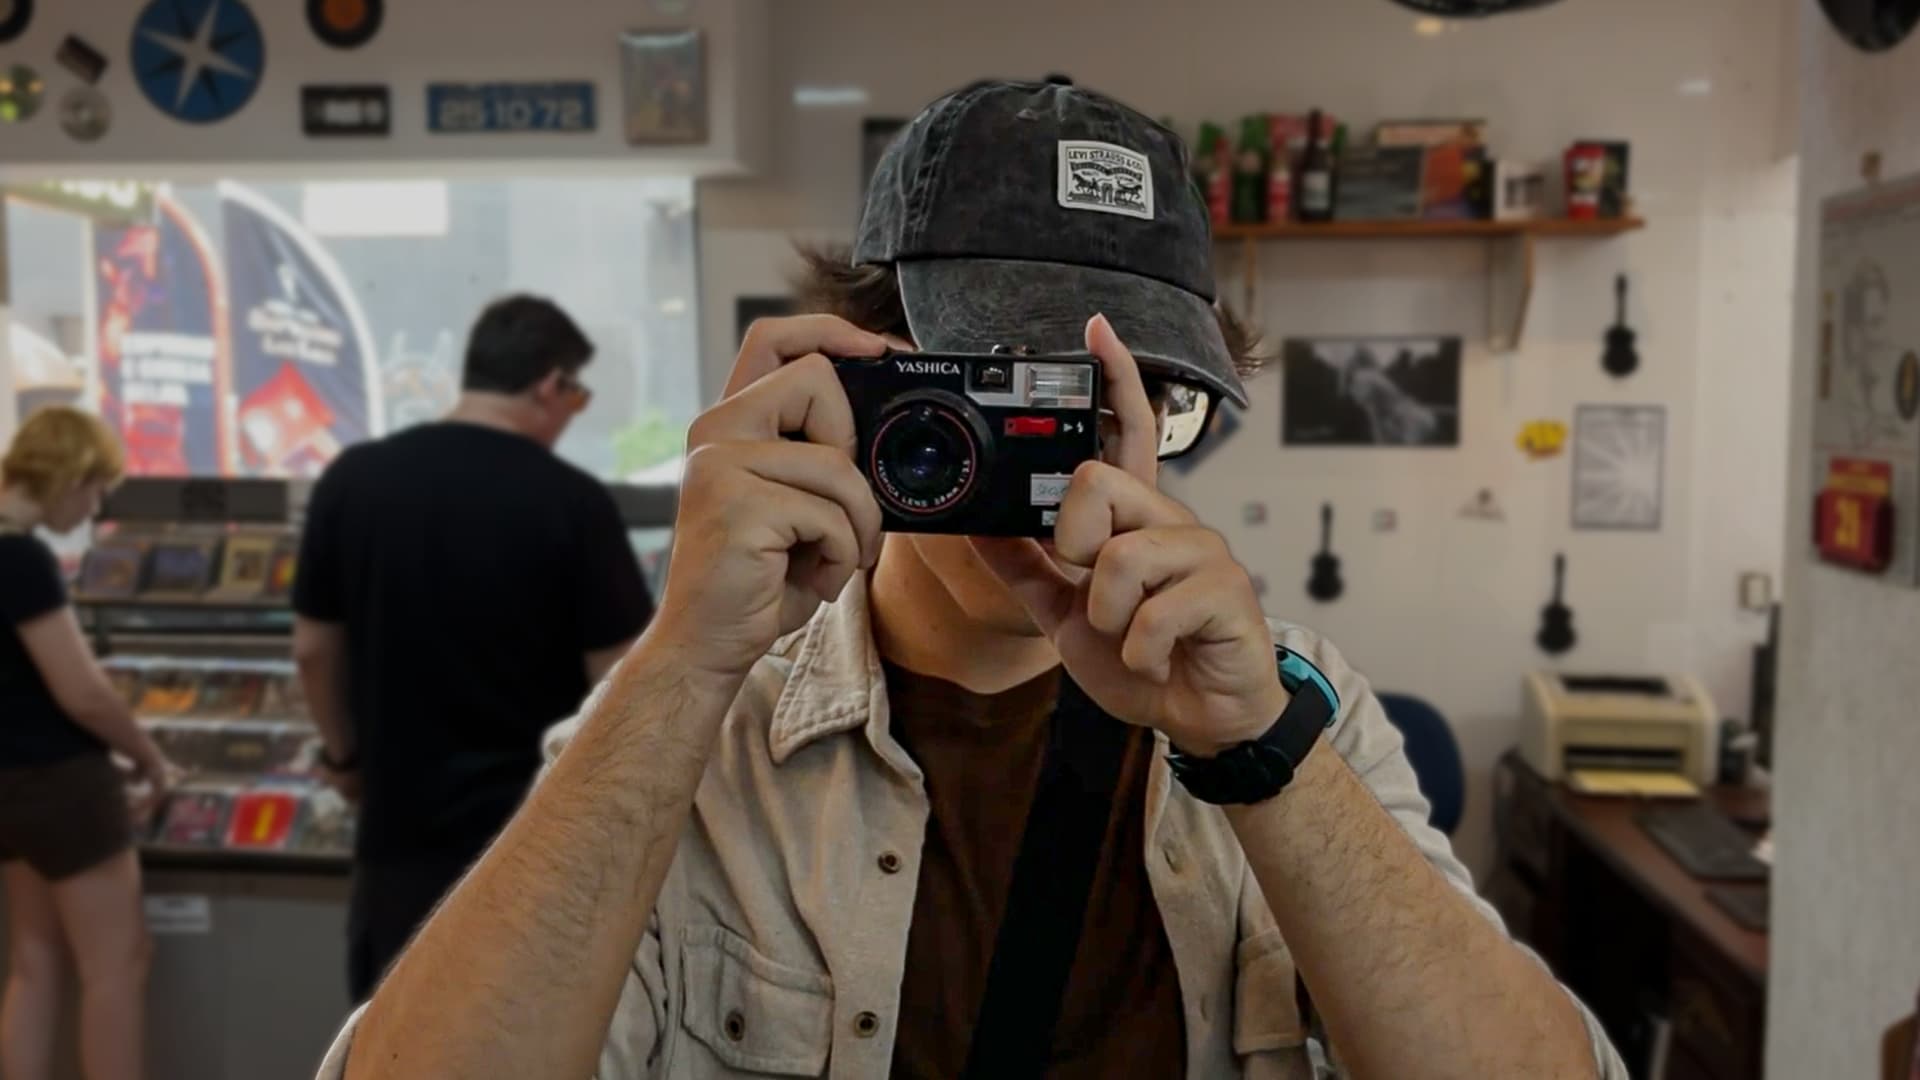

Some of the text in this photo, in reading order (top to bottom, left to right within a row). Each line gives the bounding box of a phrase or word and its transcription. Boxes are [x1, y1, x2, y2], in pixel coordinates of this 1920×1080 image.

[1068, 151, 1088, 160] LEVI
[1089, 150, 1125, 165] STRAUSS
[896, 360, 960, 375] YASHICA
[902, 496, 927, 507] LENS
